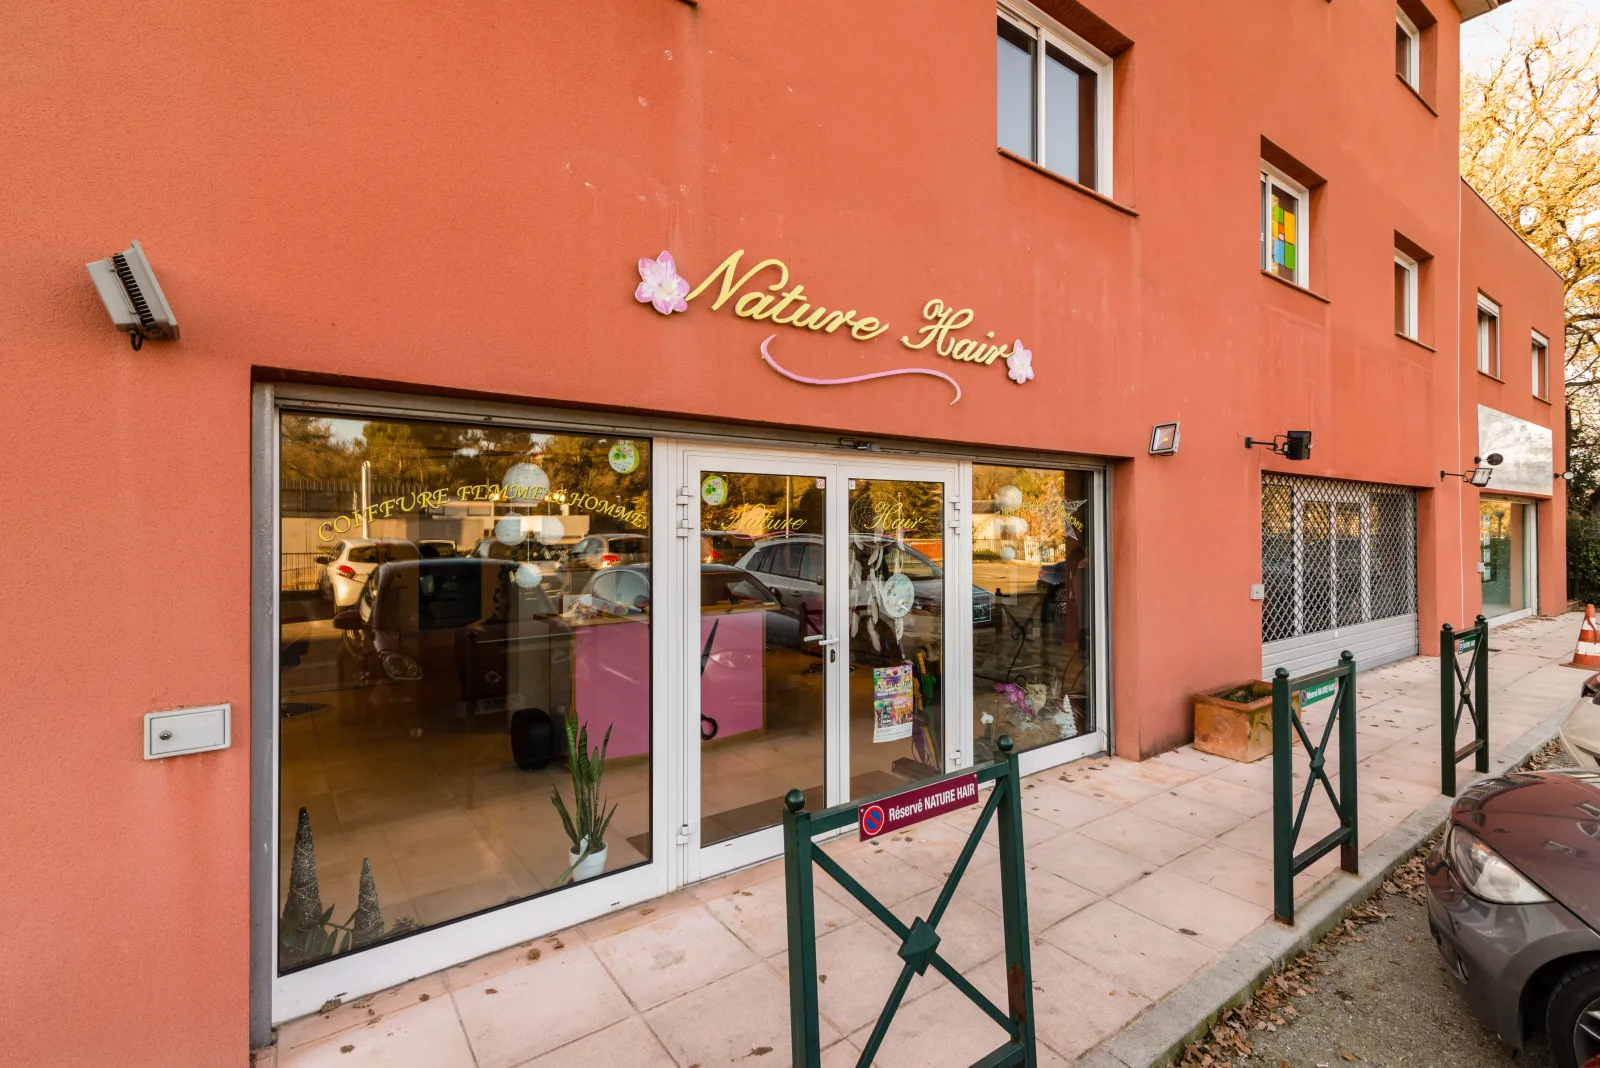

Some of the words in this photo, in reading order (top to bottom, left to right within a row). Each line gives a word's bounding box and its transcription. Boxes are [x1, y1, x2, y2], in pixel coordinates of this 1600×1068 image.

[685, 249, 889, 341] Nature
[901, 299, 1015, 366] Hair
[318, 488, 450, 542] COIFFURE
[457, 484, 547, 501] FEMME
[568, 493, 647, 527] HOMME
[720, 502, 808, 530] Nature
[864, 501, 928, 530] Hair
[888, 799, 922, 822] Réservé
[924, 789, 956, 811] NATURE
[956, 783, 976, 799] HAIR
